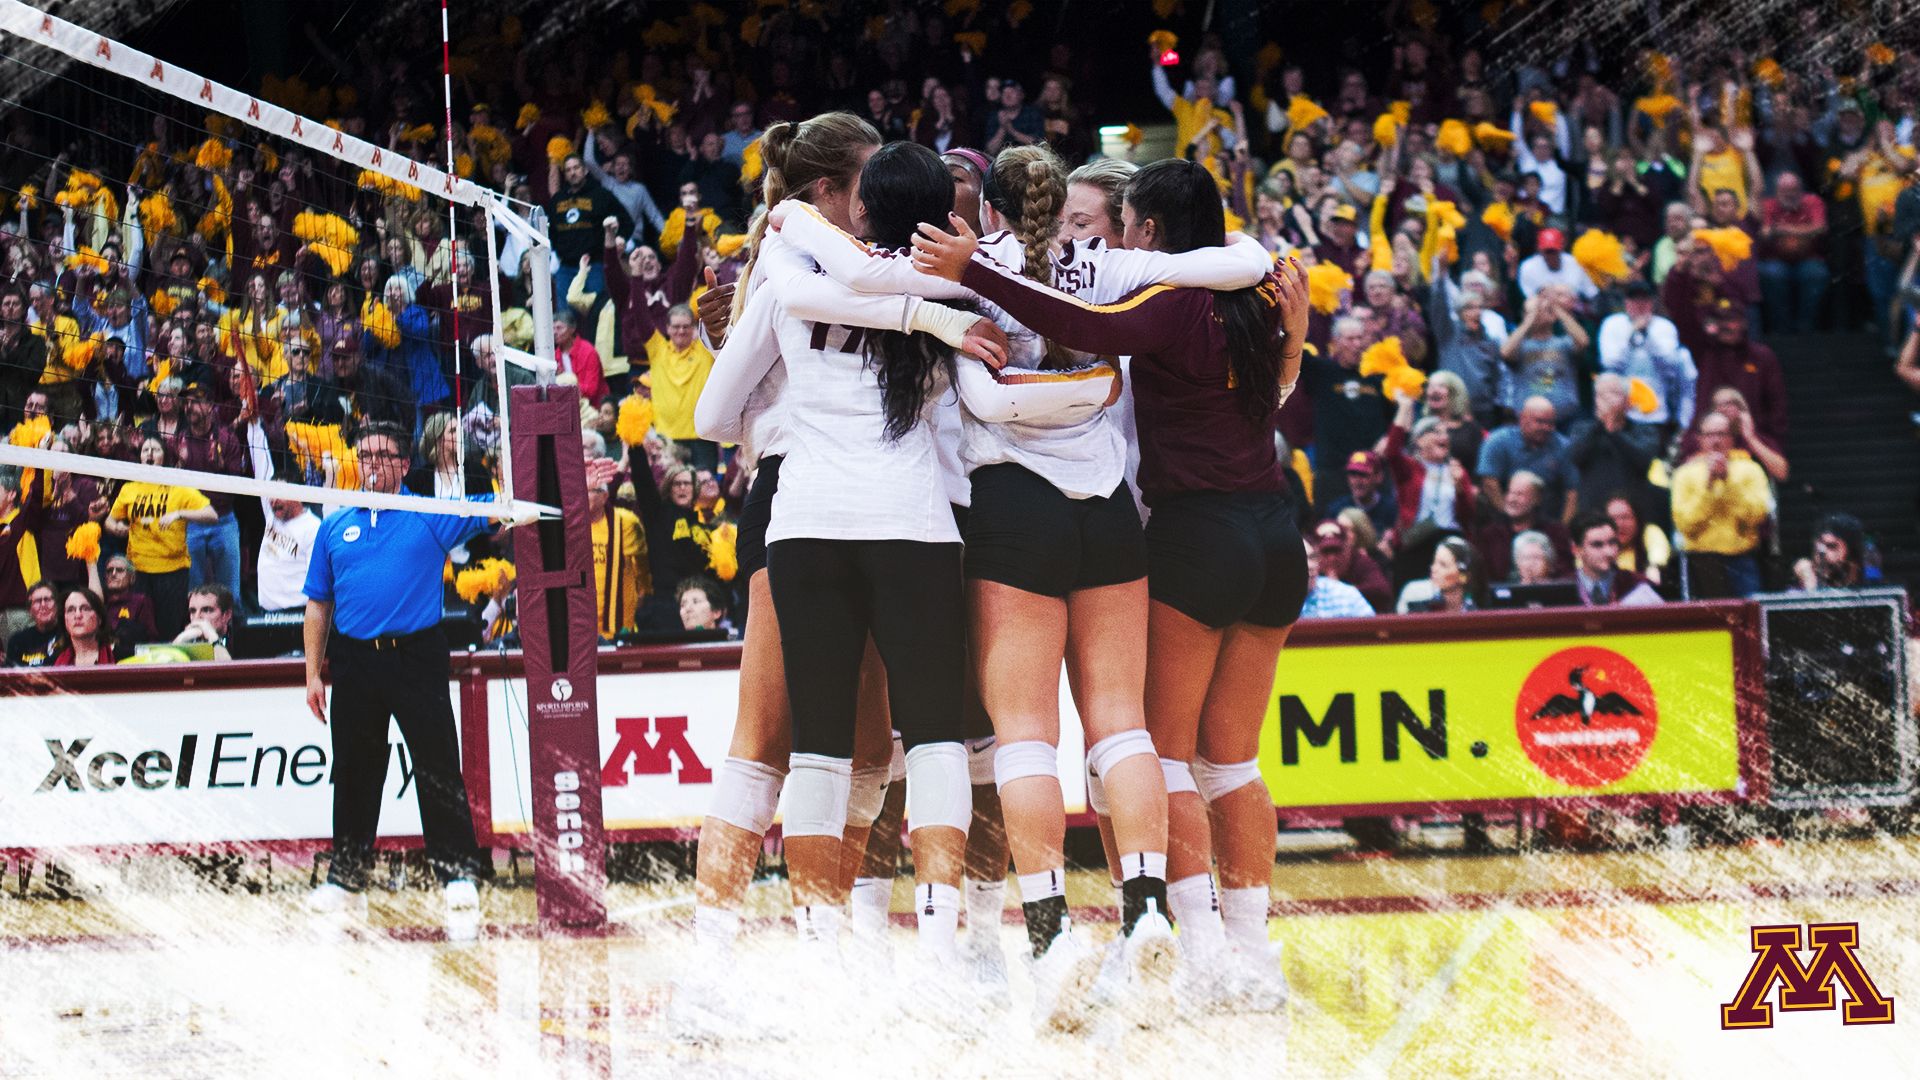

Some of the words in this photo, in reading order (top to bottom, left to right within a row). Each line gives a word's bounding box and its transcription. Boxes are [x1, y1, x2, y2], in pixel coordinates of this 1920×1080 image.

[200, 79, 213, 102] M
[601, 715, 712, 788] M
[1279, 689, 1489, 765] MN.
[33, 734, 198, 794] Xcel
[207, 732, 414, 799] Eney
